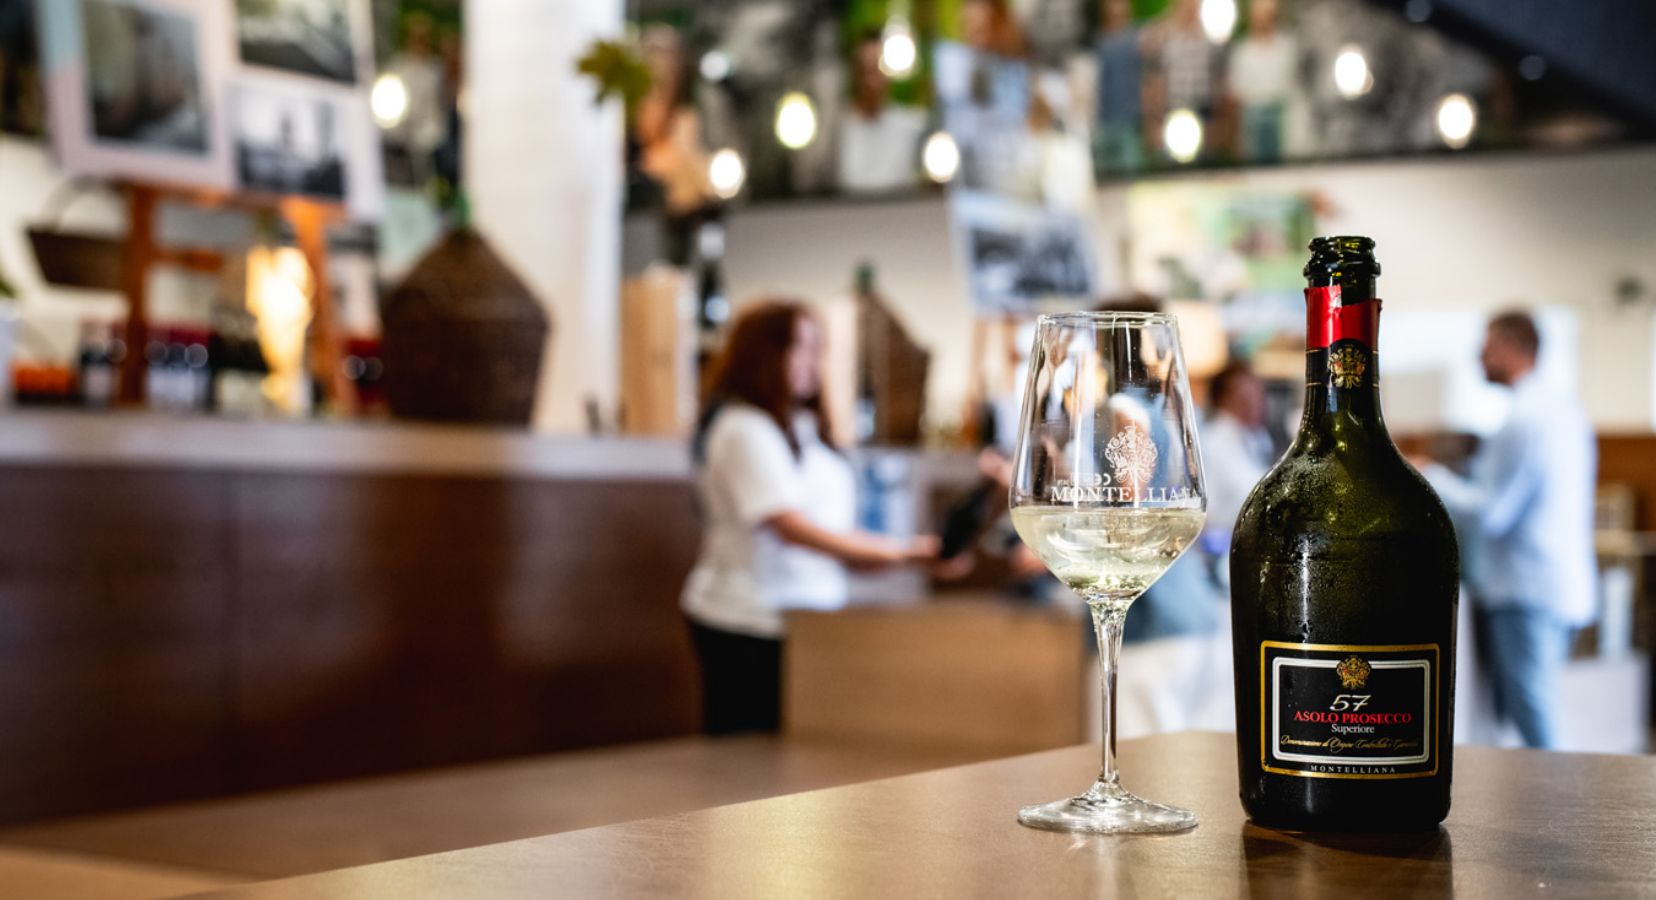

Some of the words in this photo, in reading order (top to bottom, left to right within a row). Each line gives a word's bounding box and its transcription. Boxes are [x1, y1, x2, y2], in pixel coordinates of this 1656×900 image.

[1329, 693, 1372, 712] 57
[1293, 710, 1340, 723] ASOLO
[1342, 712, 1412, 725] PROSECCO
[1330, 723, 1375, 735] Superiore
[1310, 764, 1396, 774] MONTELLIANA
